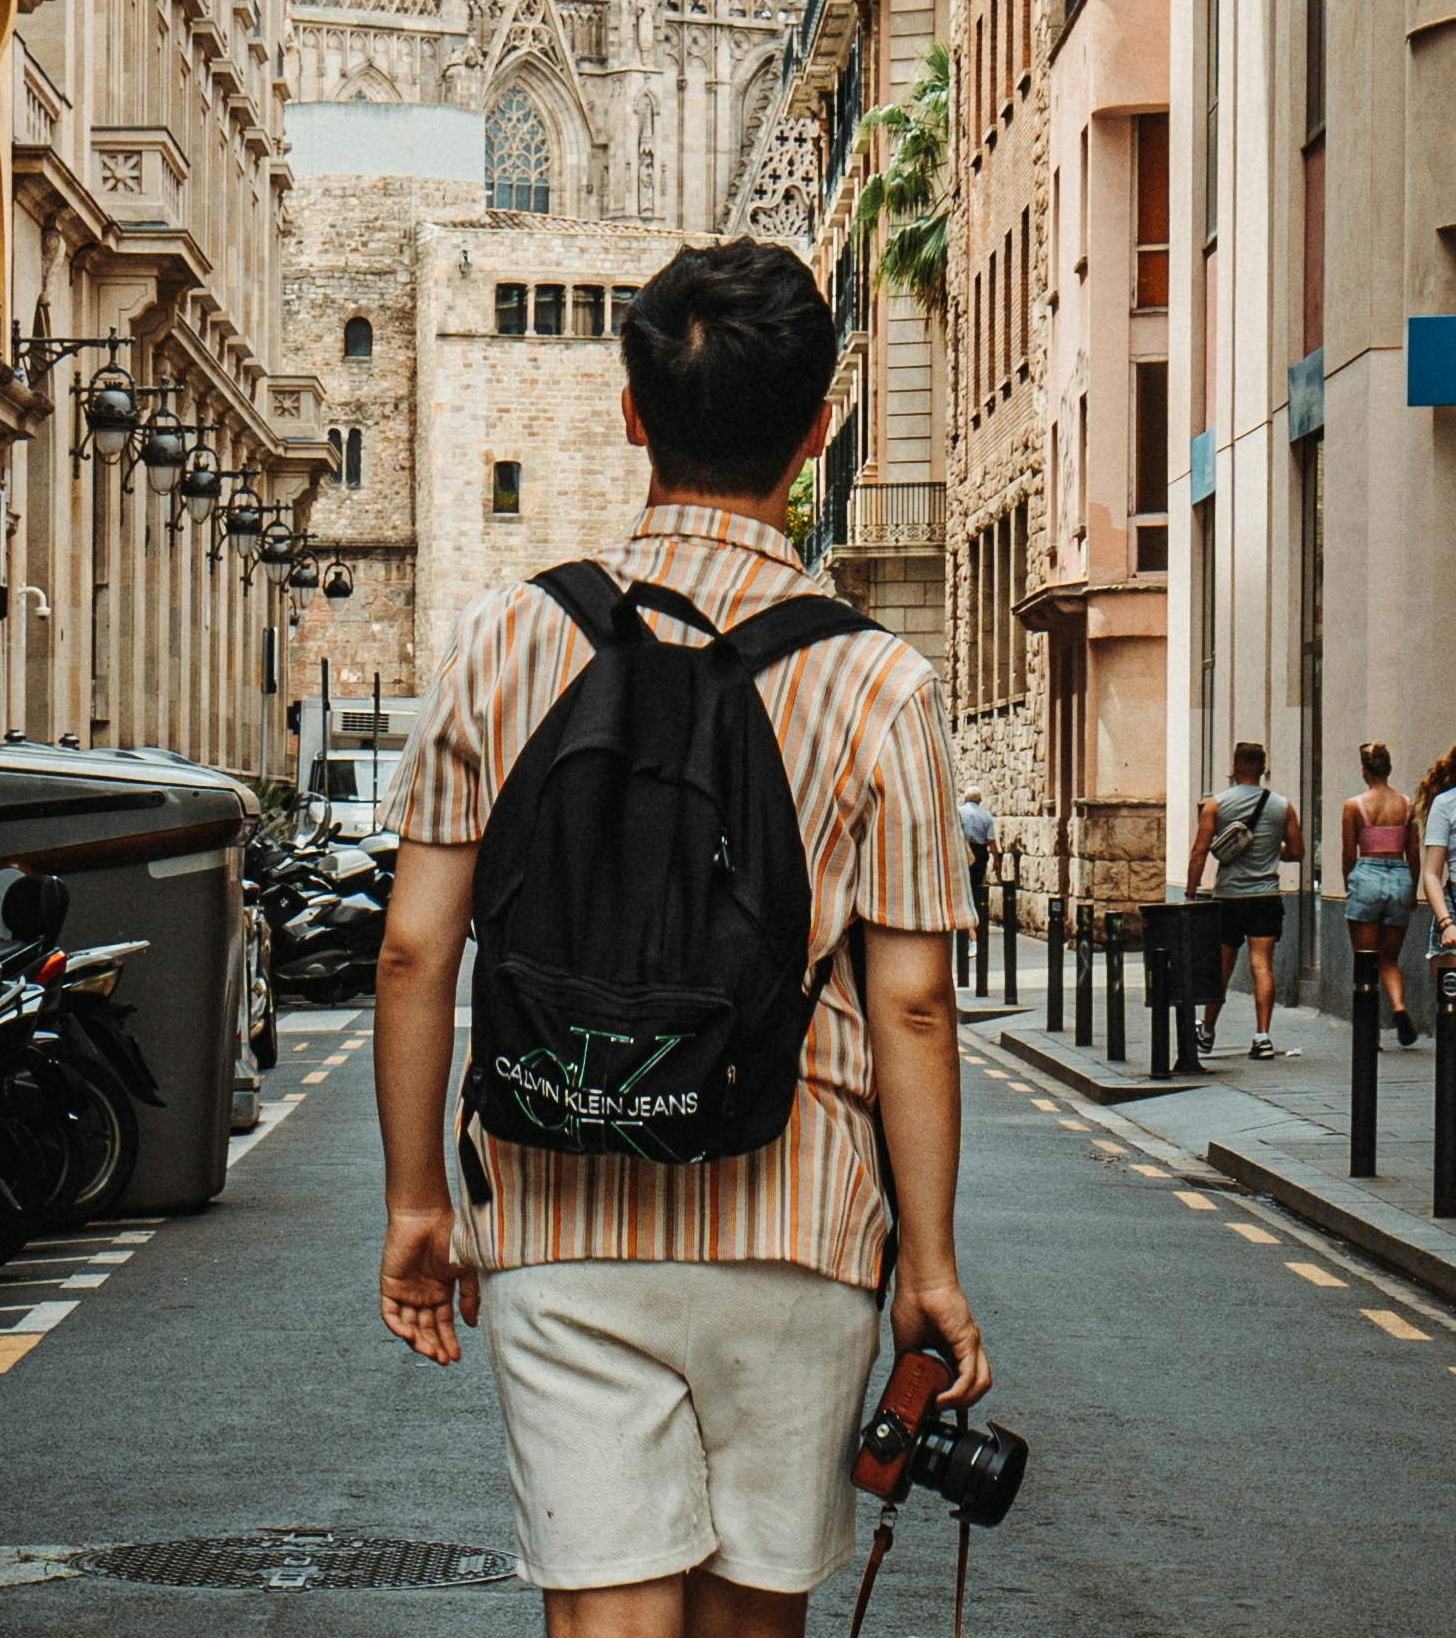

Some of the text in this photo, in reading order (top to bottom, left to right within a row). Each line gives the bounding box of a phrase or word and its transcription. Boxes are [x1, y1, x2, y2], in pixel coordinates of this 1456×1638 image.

[495, 1055, 699, 1118] CALVIN KLEIN JEANS
